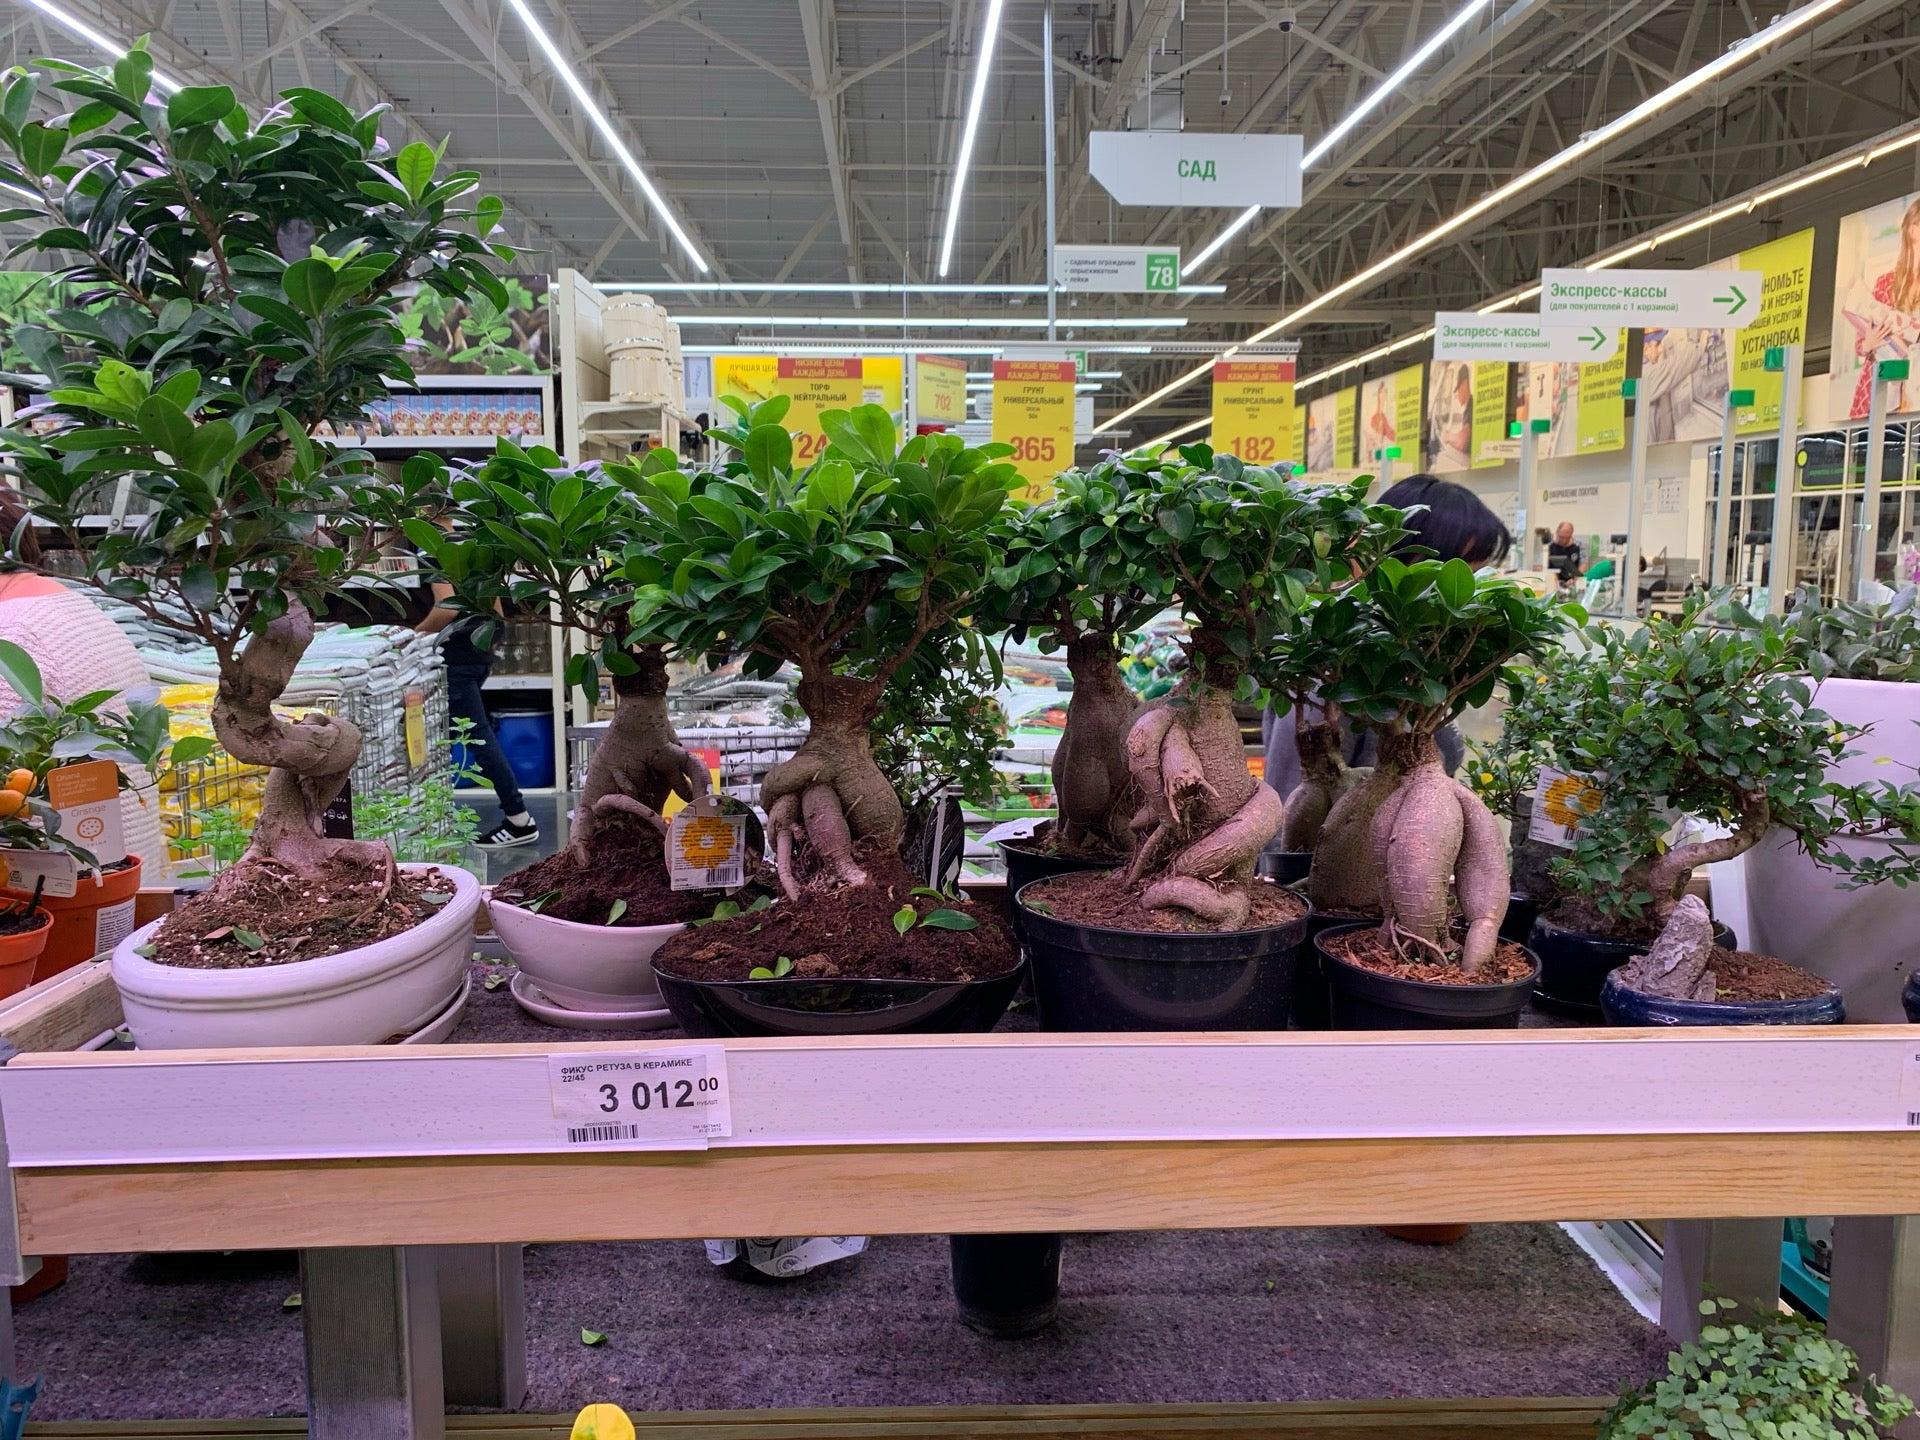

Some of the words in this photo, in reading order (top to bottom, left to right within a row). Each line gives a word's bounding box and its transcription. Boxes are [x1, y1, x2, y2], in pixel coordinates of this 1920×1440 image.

[1178, 160, 1216, 181] САД
[1149, 266, 1173, 287] 78
[1761, 267, 1805, 293] НОМЬТЕ
[1550, 283, 1667, 300] Экспресс-кассы
[1775, 289, 1804, 307] НЕРВЫ
[1569, 301, 1621, 312] покупателей
[1637, 302, 1679, 312] корзиной)
[1772, 307, 1803, 325] УСЛУГОЙ
[1443, 325, 1541, 338] Экспресс-кассы
[1742, 326, 1801, 355] УСТАНОВКА
[825, 359, 845, 368] ЦЕНЫ
[792, 368, 825, 378] КАЖДЫЙ
[810, 383, 830, 391] ТОРФ
[1242, 387, 1264, 395] ГРУНТ
[793, 391, 847, 401] НЕЙТРАЛЬНЫЙ
[1003, 395, 1064, 405] УНИВЕРСАЛЬНЫЙ
[1223, 395, 1284, 405] УНИВЕРСАЛЬНЫЙ
[1010, 436, 1055, 462] 365
[1230, 435, 1275, 461] 182
[561, 1064, 594, 1076] ФИКУС
[597, 1062, 632, 1072] РЕТУЗА
[634, 1062, 641, 1070] В
[643, 1058, 693, 1069] КЕРАМИКЕ
[562, 1073, 586, 1083] 22/45
[599, 1083, 619, 1113] 3
[632, 1079, 695, 1111] 012
[698, 1076, 719, 1092] 00
